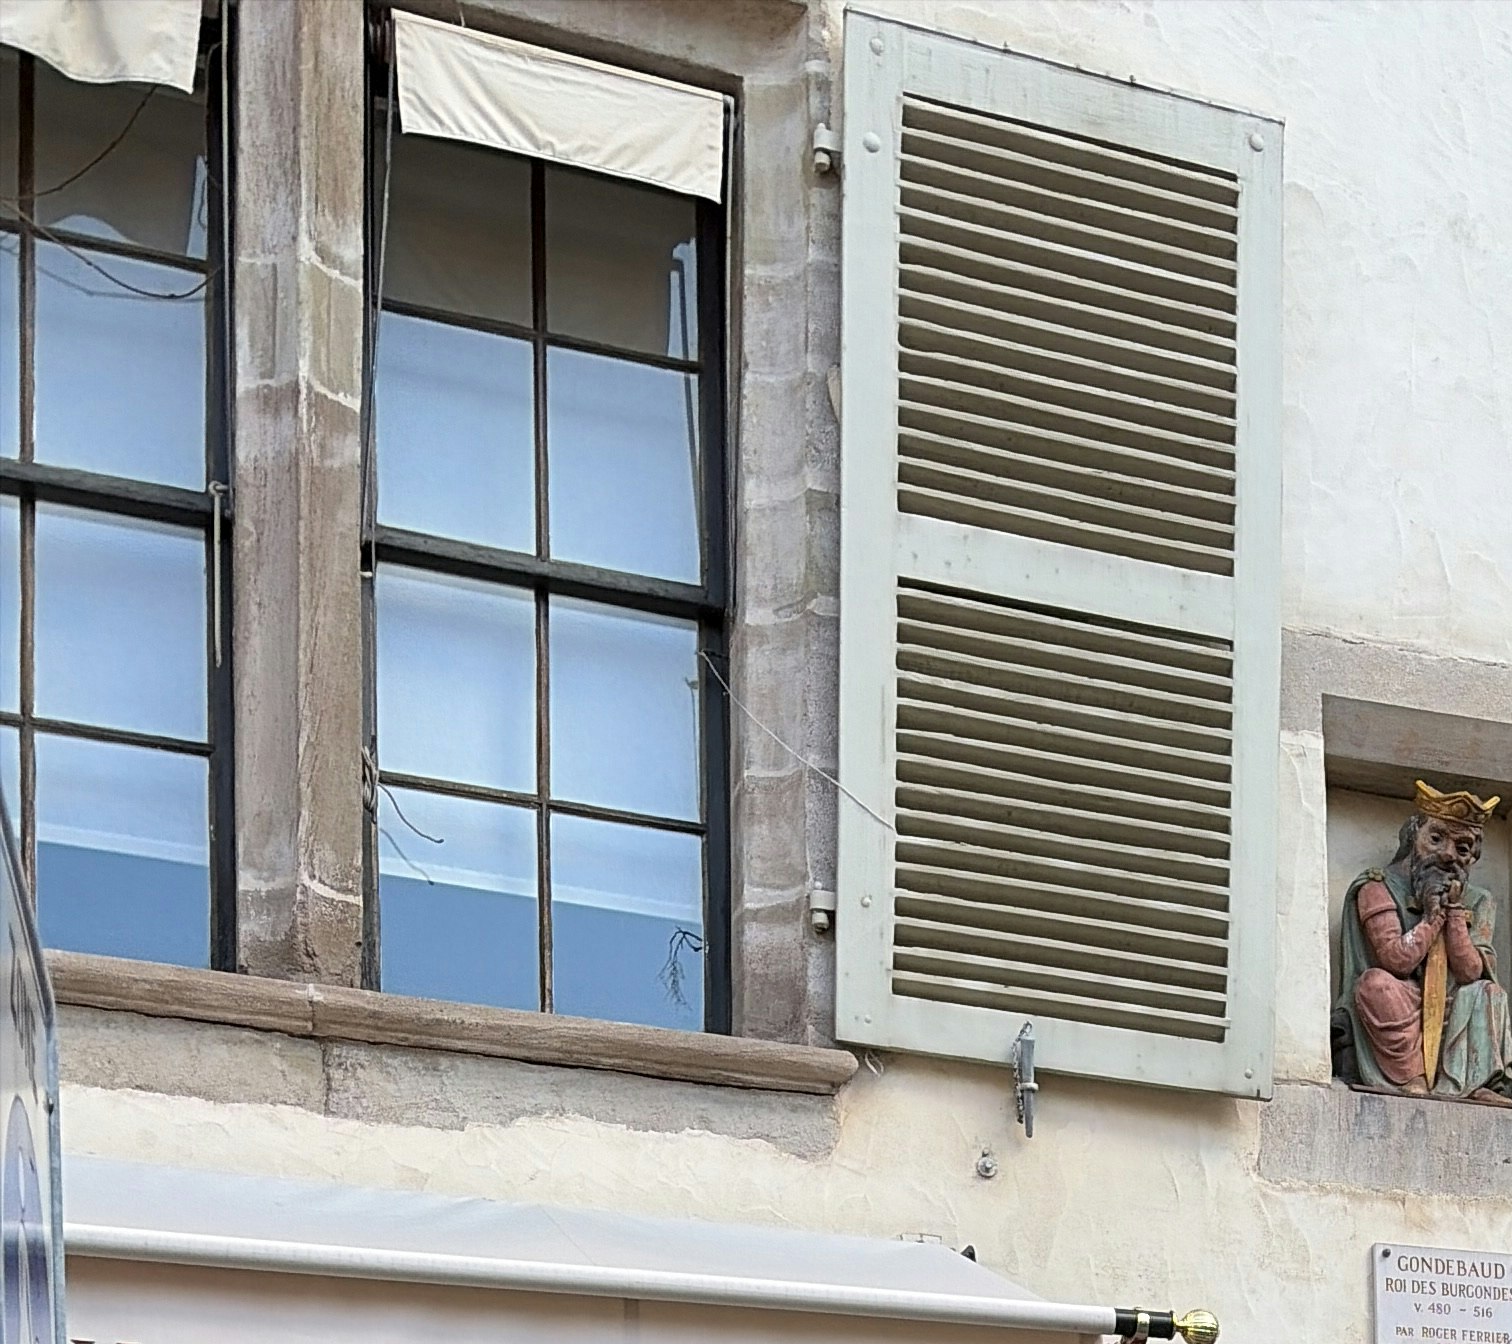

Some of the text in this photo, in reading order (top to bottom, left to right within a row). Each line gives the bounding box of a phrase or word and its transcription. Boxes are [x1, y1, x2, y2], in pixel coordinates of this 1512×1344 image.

[1397, 1255, 1505, 1280] GONDEBAUD
[1385, 1277, 1407, 1293] ROI
[1411, 1280, 1437, 1295] DES
[1428, 1302, 1451, 1315] 480
[1473, 1306, 1493, 1319] 516
[1395, 1326, 1511, 1344] PAR ROGER FERRIER
